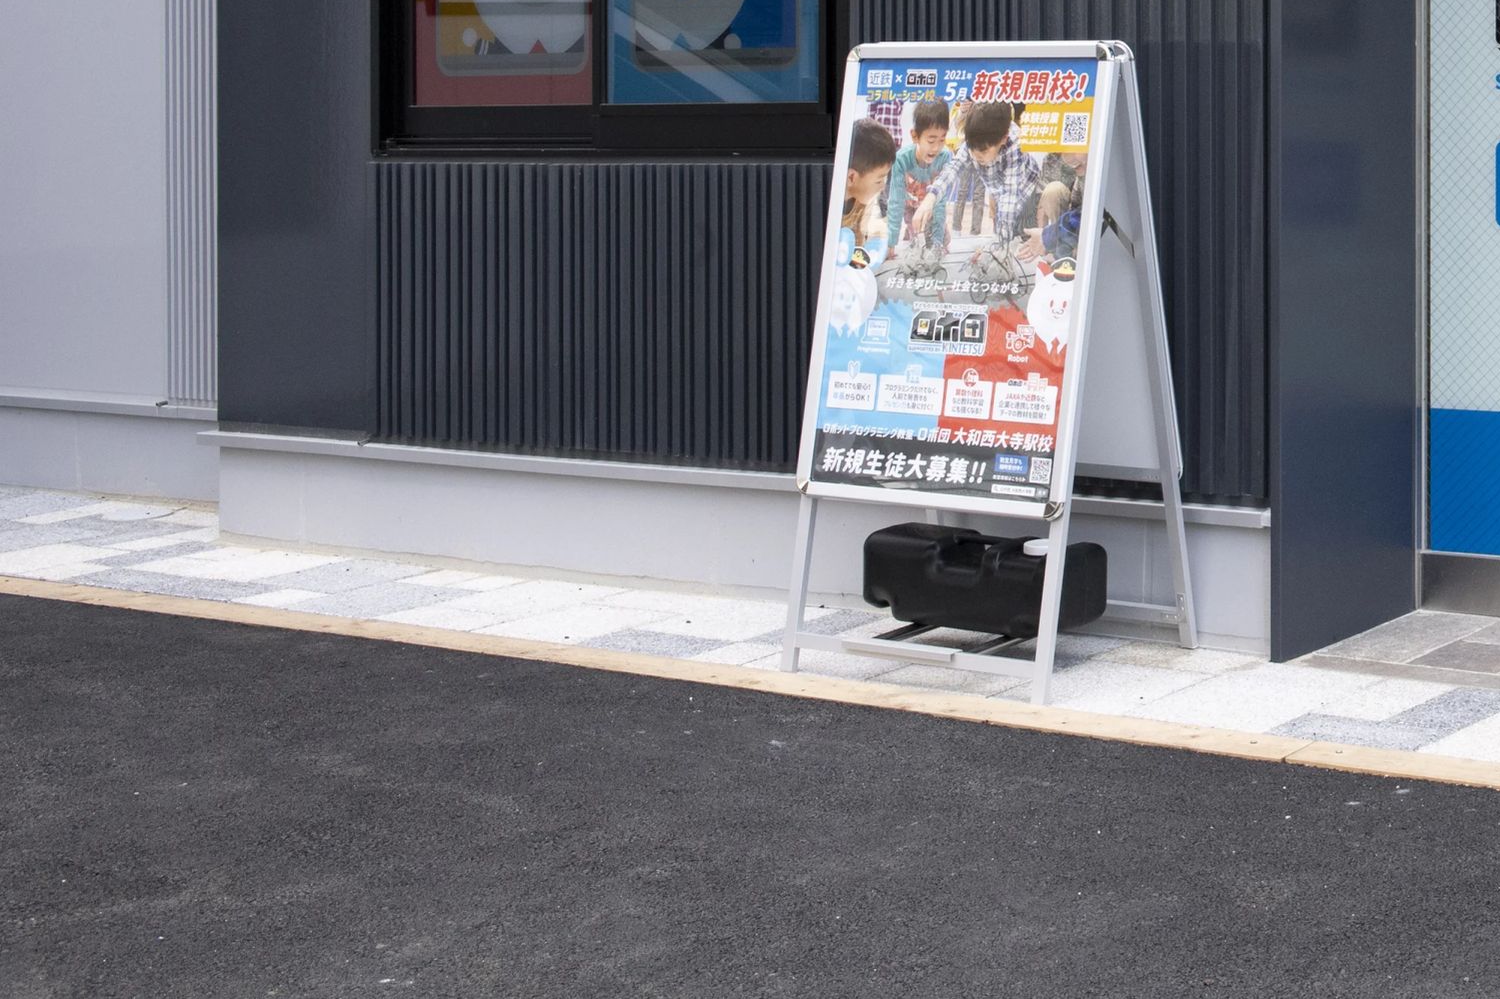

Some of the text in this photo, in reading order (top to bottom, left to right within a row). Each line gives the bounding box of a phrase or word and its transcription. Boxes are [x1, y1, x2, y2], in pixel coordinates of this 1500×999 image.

[943, 82, 968, 100] 5月
[1007, 354, 1029, 363] Robot
[951, 427, 1054, 452] 大和西大寺駅校
